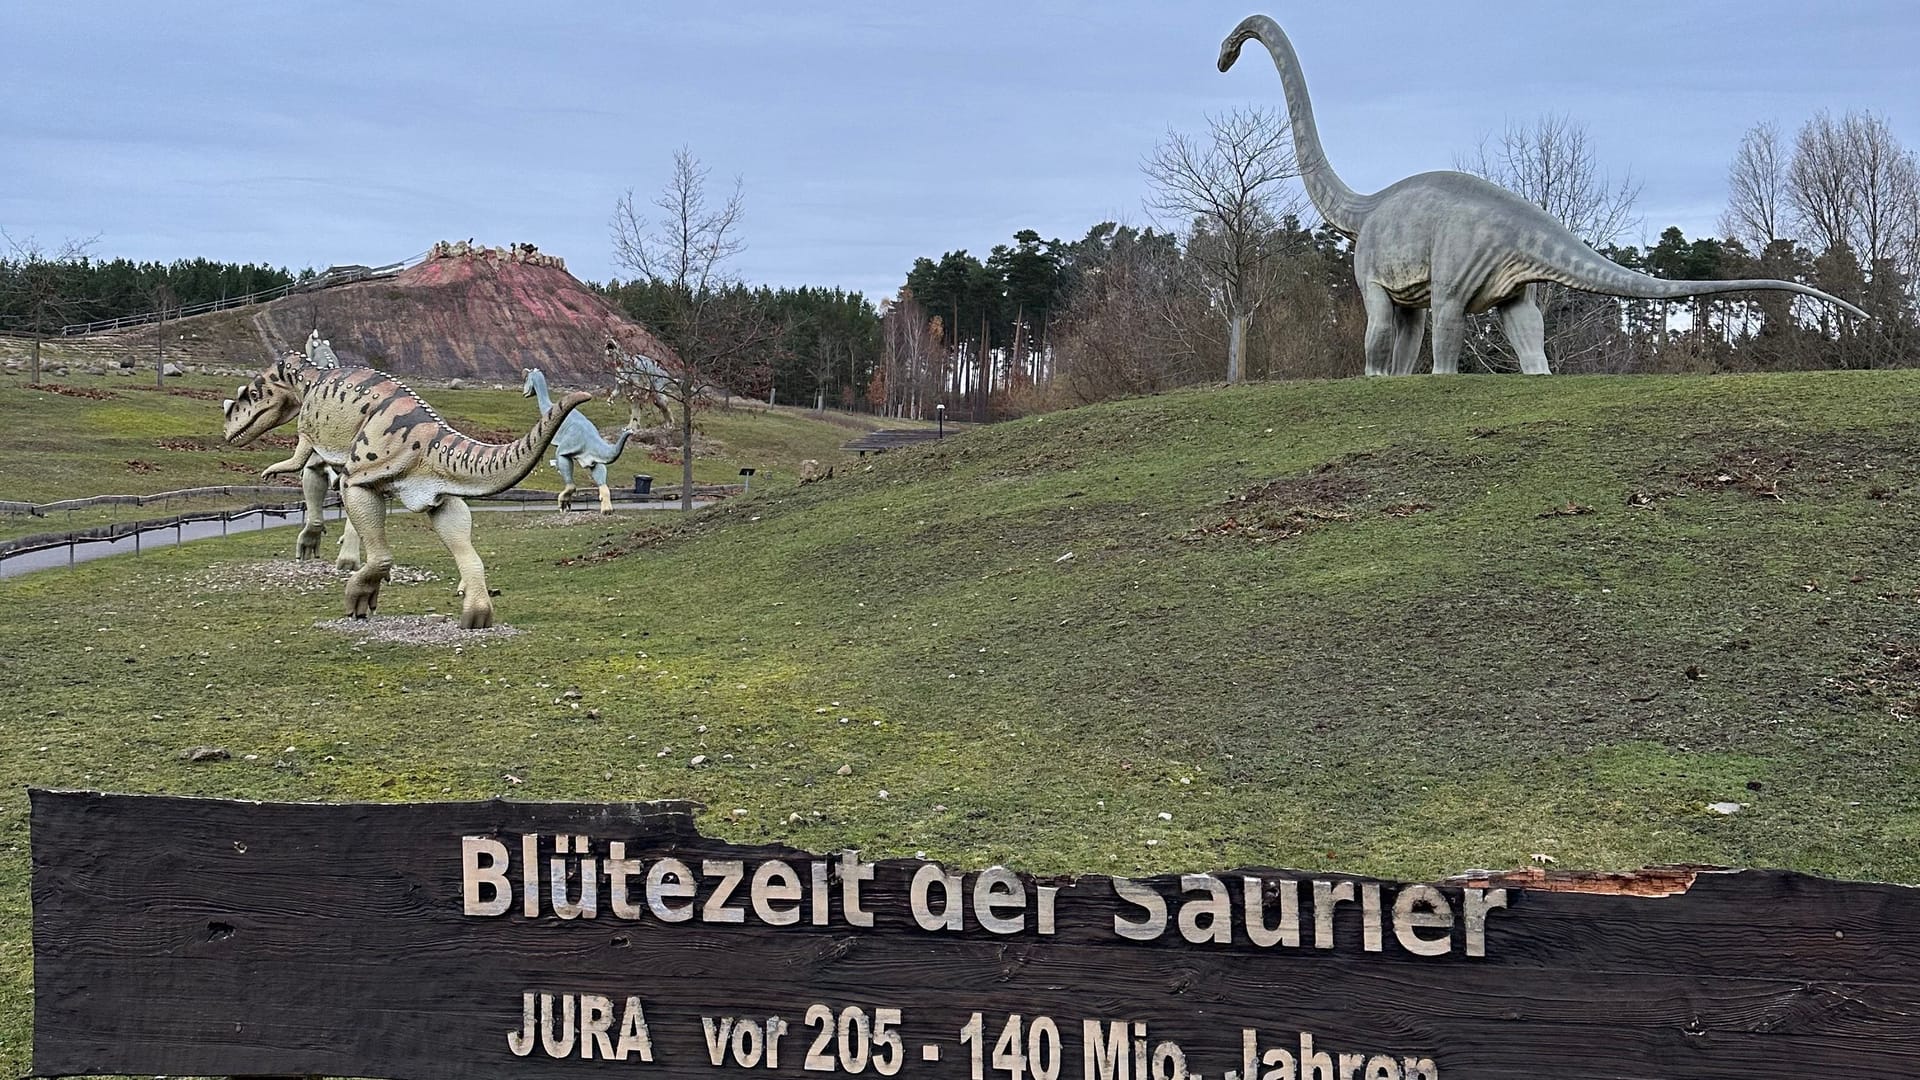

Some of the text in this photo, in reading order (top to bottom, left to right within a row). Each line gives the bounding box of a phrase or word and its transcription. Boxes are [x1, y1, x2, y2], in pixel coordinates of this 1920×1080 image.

[461, 834, 876, 928] Blütezeit
[507, 992, 654, 1062] JURA
[702, 1015, 789, 1069] vor
[804, 1004, 904, 1077] 205
[960, 1012, 1060, 1080] 140
